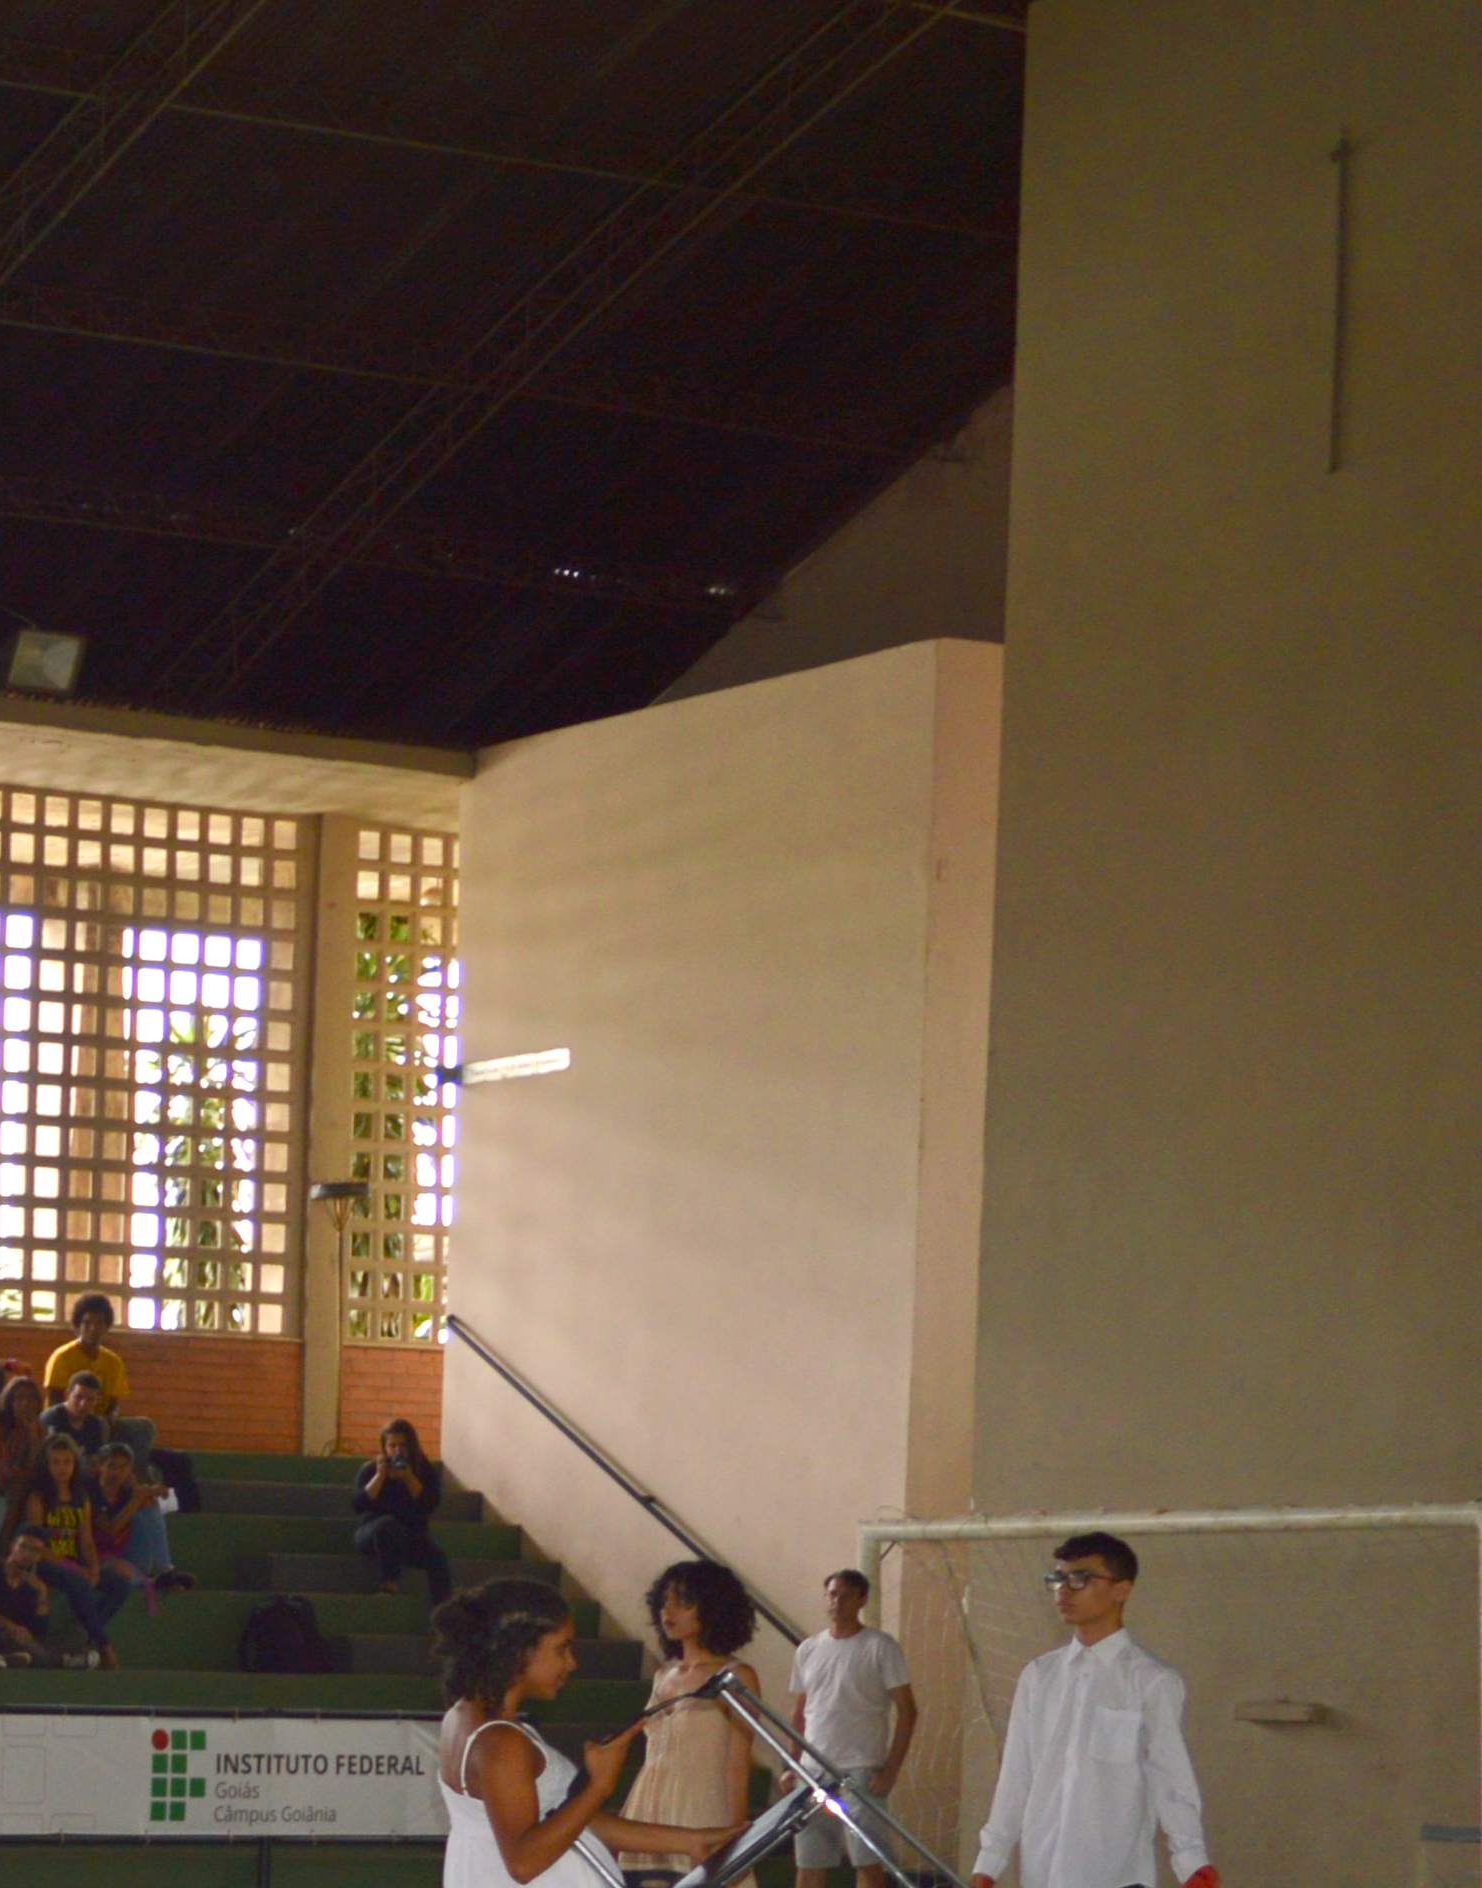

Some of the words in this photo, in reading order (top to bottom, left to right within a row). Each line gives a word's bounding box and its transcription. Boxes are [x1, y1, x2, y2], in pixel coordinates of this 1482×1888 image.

[215, 1753, 329, 1775] INSTITUTO
[335, 1754, 425, 1776] FEDERAL
[214, 1780, 260, 1799] Goiás
[213, 1804, 277, 1827] Câmpus
[281, 1805, 337, 1823] Goiânia
